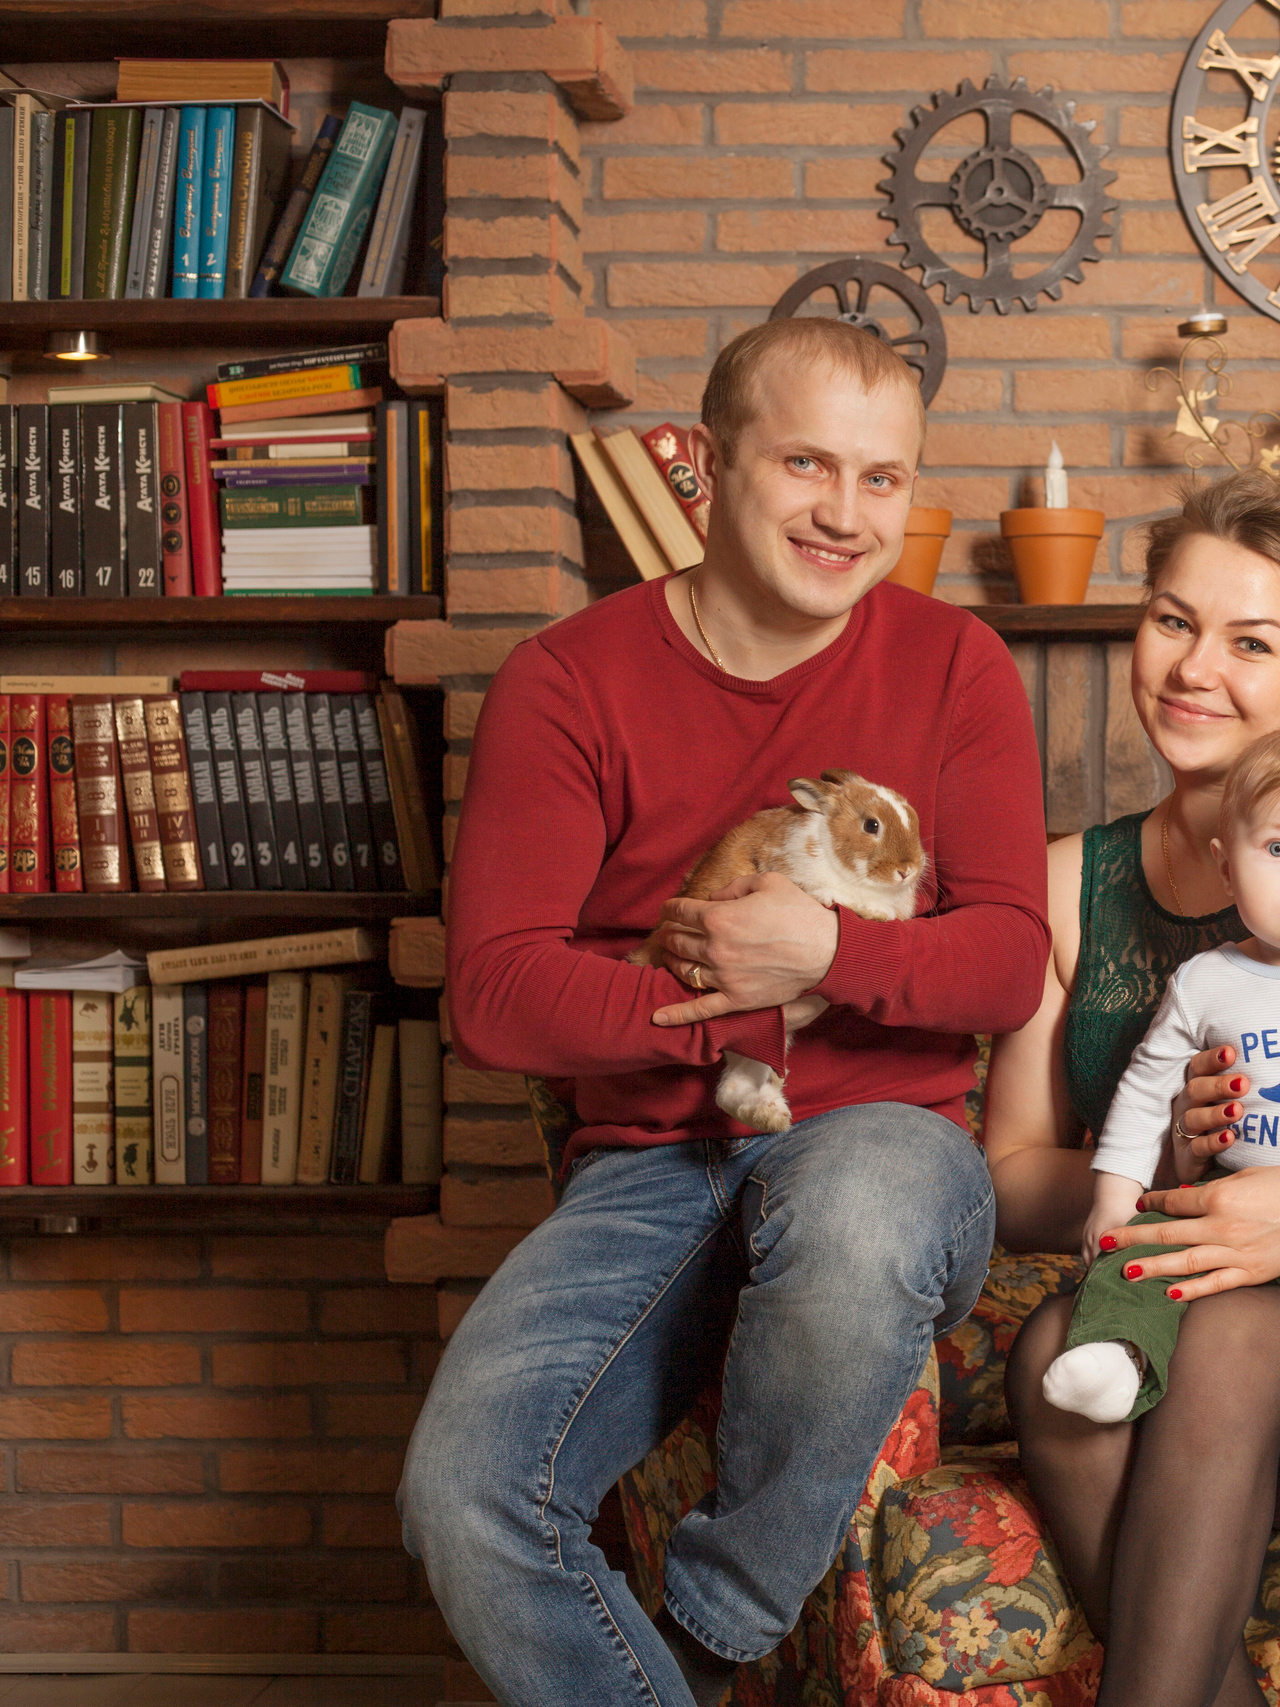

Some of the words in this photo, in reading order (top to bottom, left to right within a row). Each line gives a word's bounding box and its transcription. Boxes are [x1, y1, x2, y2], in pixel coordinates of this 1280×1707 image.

[1183, 115, 1260, 173] IX
[238, 131, 253, 200] СИМОНОВ
[17, 191, 25, 245] СТИХОТВОРЕНИЯ
[231, 201, 248, 270] Константин
[182, 254, 190, 266] 1
[206, 253, 217, 266] 2
[25, 566, 41, 586] 15
[59, 569, 74, 588] 16
[96, 566, 112, 586] 17
[138, 568, 155, 587] 22
[193, 761, 214, 804] КОНАН
[217, 760, 239, 804] КОНАН
[244, 760, 266, 803] КОНАН
[270, 759, 292, 802] КОНАН
[293, 761, 315, 804] КОНАН
[319, 761, 342, 803] КОНАН
[208, 842, 219, 866] 1
[231, 842, 246, 866] 2
[257, 842, 272, 866] 3
[283, 841, 298, 864] 4
[308, 843, 321, 867] 5
[333, 842, 347, 866] 6
[357, 844, 368, 867] 7
[382, 842, 397, 865] 8
[344, 998, 370, 1097] СПАРТАК
